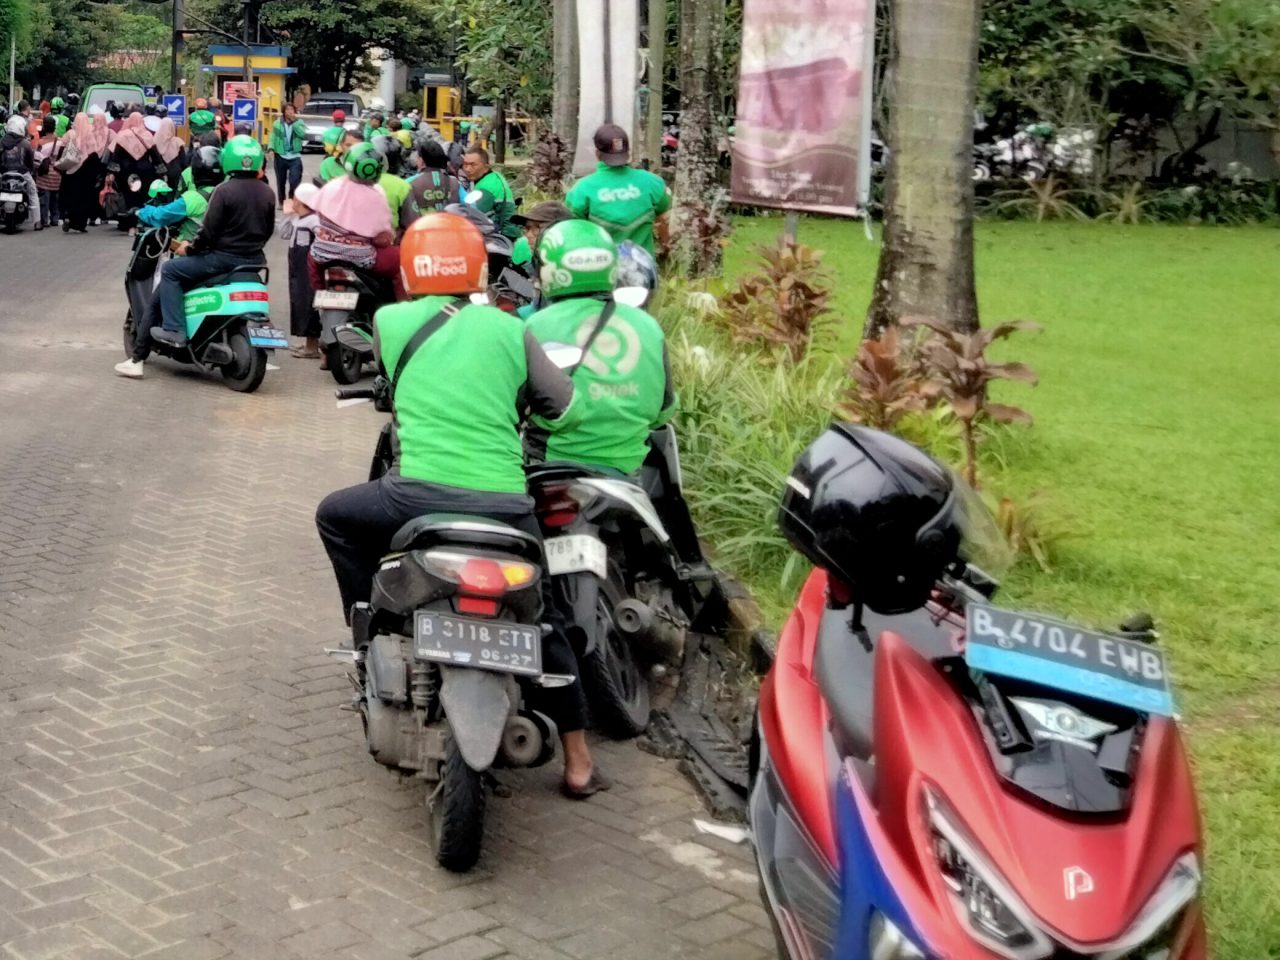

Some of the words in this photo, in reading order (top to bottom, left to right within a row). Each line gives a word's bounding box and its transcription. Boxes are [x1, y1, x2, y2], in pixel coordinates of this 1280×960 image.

[597, 184, 640, 202] Grab
[432, 265, 468, 278] Food
[422, 618, 434, 636] B
[973, 608, 993, 637] B
[1008, 618, 1087, 659] 4704
[1097, 638, 1163, 680] EWB
